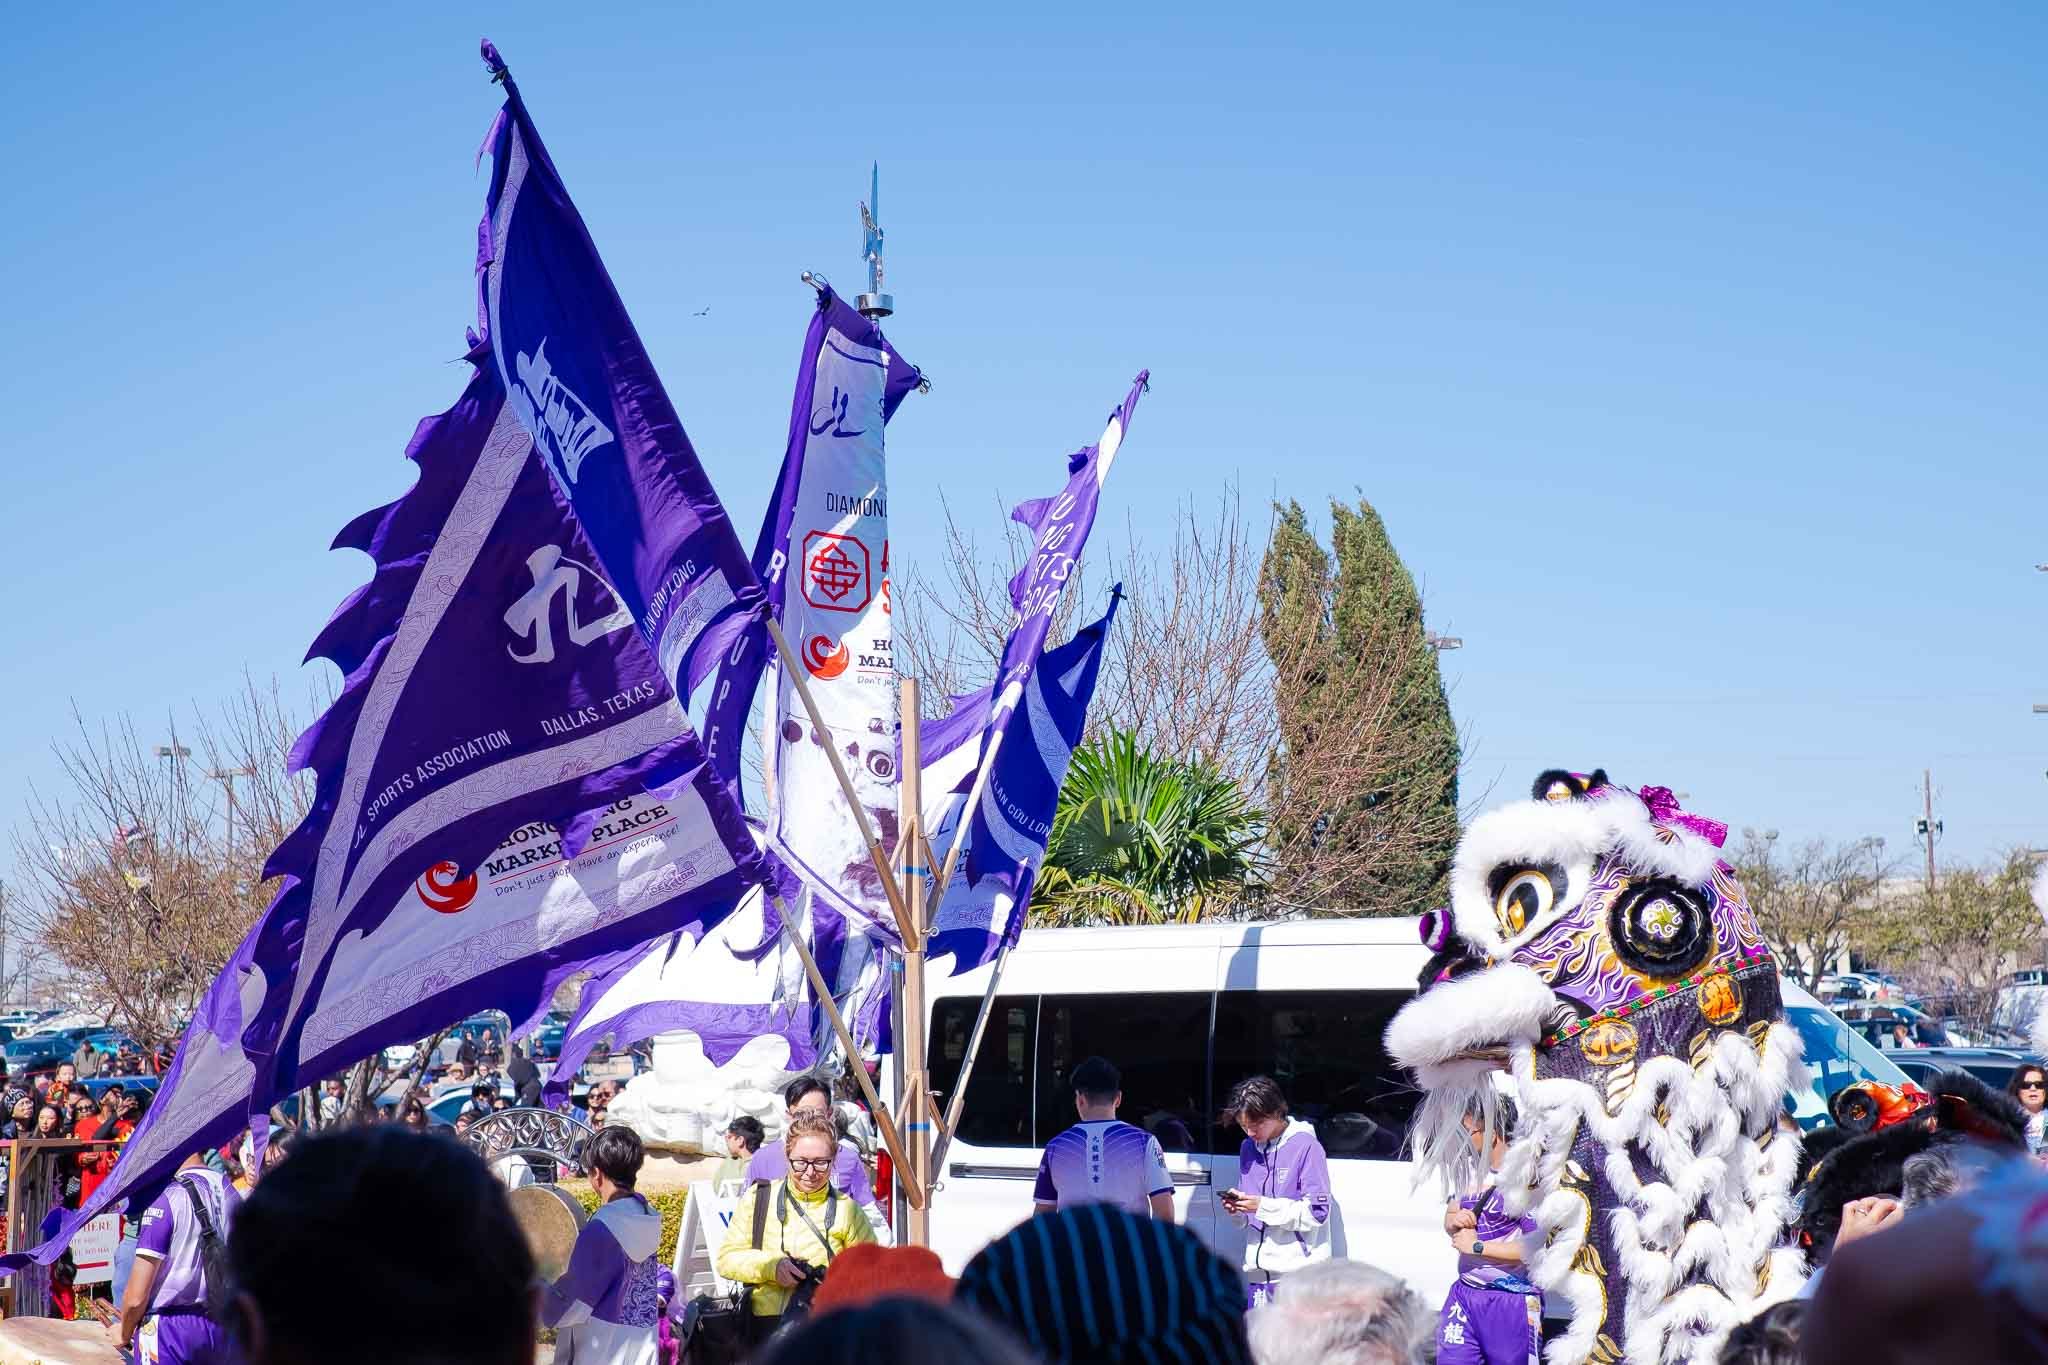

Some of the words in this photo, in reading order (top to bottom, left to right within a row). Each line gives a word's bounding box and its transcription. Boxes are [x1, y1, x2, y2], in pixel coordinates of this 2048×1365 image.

[367, 772, 415, 823] SPORTS
[415, 728, 513, 783] ASSOCIATION
[603, 680, 656, 715] TEXAS
[485, 840, 563, 878] MARK
[591, 804, 670, 842] PLACE
[495, 881, 522, 897] Don't
[526, 873, 546, 890] just
[578, 857, 605, 870] Have
[606, 850, 621, 860] an
[623, 823, 681, 854] experience!
